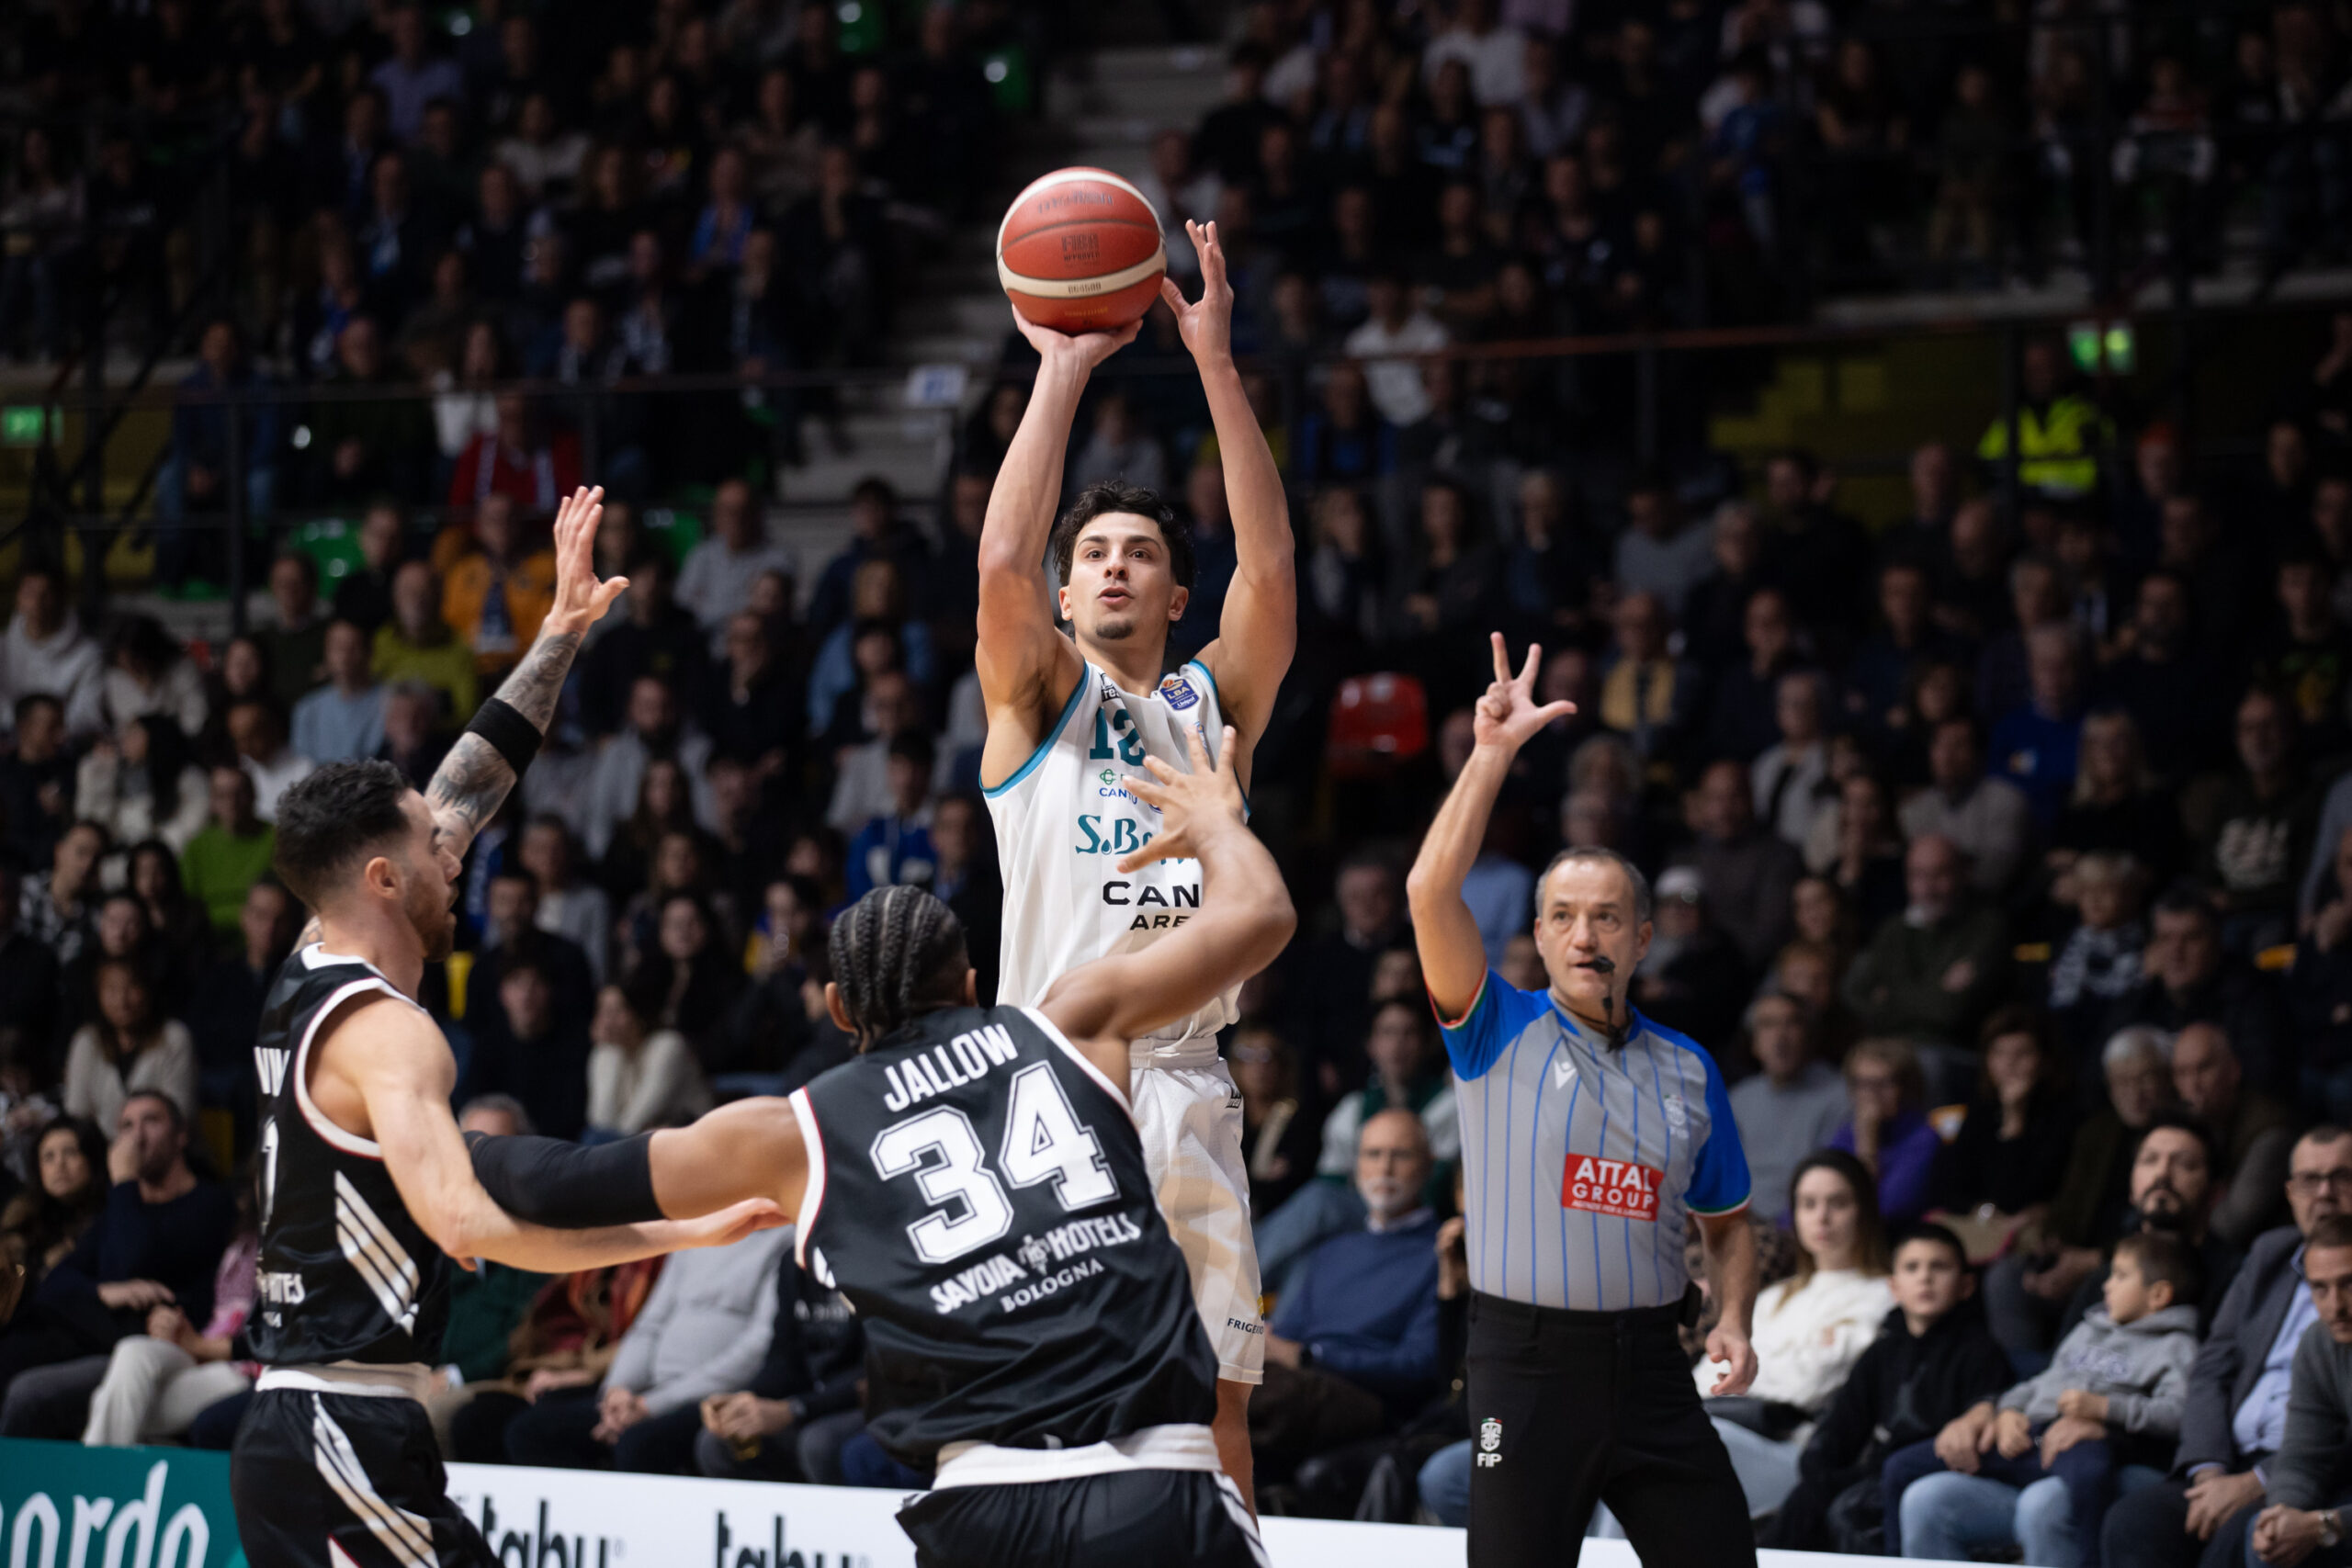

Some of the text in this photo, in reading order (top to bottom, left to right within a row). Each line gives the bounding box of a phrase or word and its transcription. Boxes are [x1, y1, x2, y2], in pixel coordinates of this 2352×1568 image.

[1168, 687, 1191, 699] LBA
[884, 1022, 1018, 1111] JALLOW
[869, 1060, 1121, 1263] 34
[1574, 1157, 1654, 1191] ATTAL
[1572, 1182, 1655, 1210] GROUP
[929, 1213, 1141, 1314] SAVOIA HOTELS
[1001, 1258, 1104, 1313] BOLOGNA
[1477, 1452, 1502, 1467] FIP
